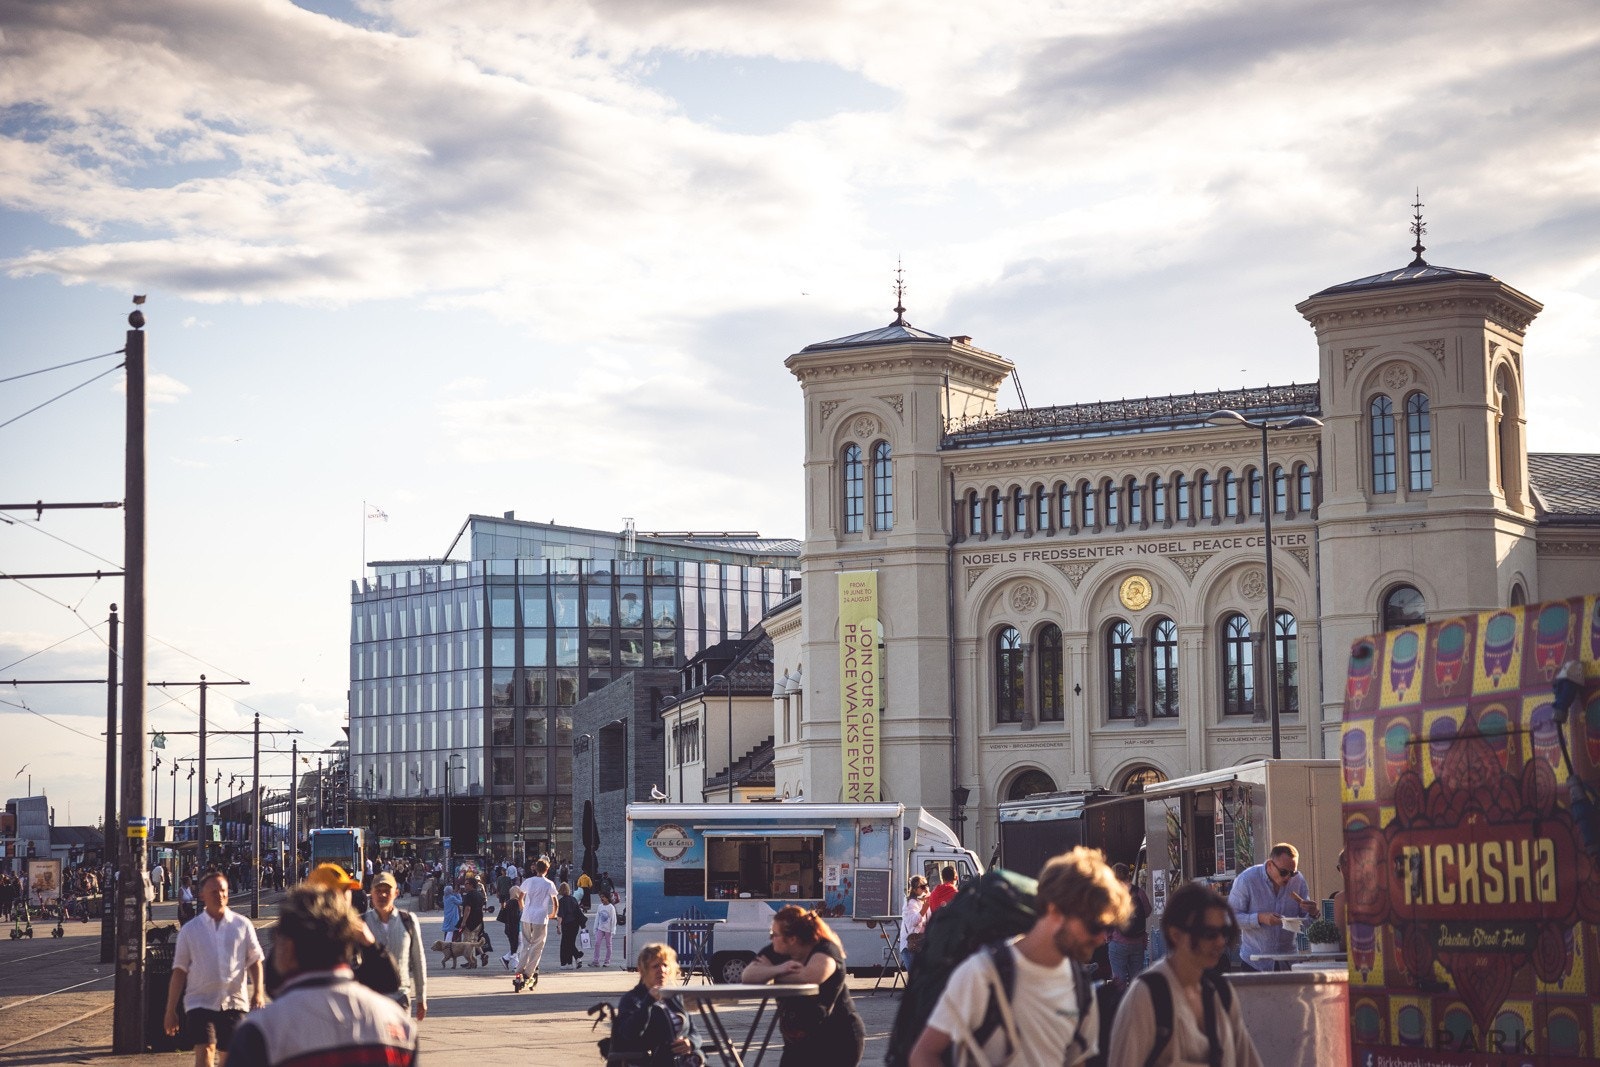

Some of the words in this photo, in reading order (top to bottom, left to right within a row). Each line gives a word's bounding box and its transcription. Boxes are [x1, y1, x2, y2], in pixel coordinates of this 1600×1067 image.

[962, 552, 1017, 565] NOBELS
[1023, 545, 1124, 561] FREDSSENTER
[1137, 541, 1187, 554] NOBEL
[1193, 537, 1243, 550] PEACE
[845, 624, 858, 678] PEACE
[860, 625, 873, 666] JOIN
[861, 670, 874, 708] OUR
[846, 682, 859, 743] WALKS
[862, 712, 875, 777] GUIDED
[847, 748, 860, 803] EVERY
[1501, 928, 1526, 948] Food
[1437, 1029, 1535, 1055] PARK
